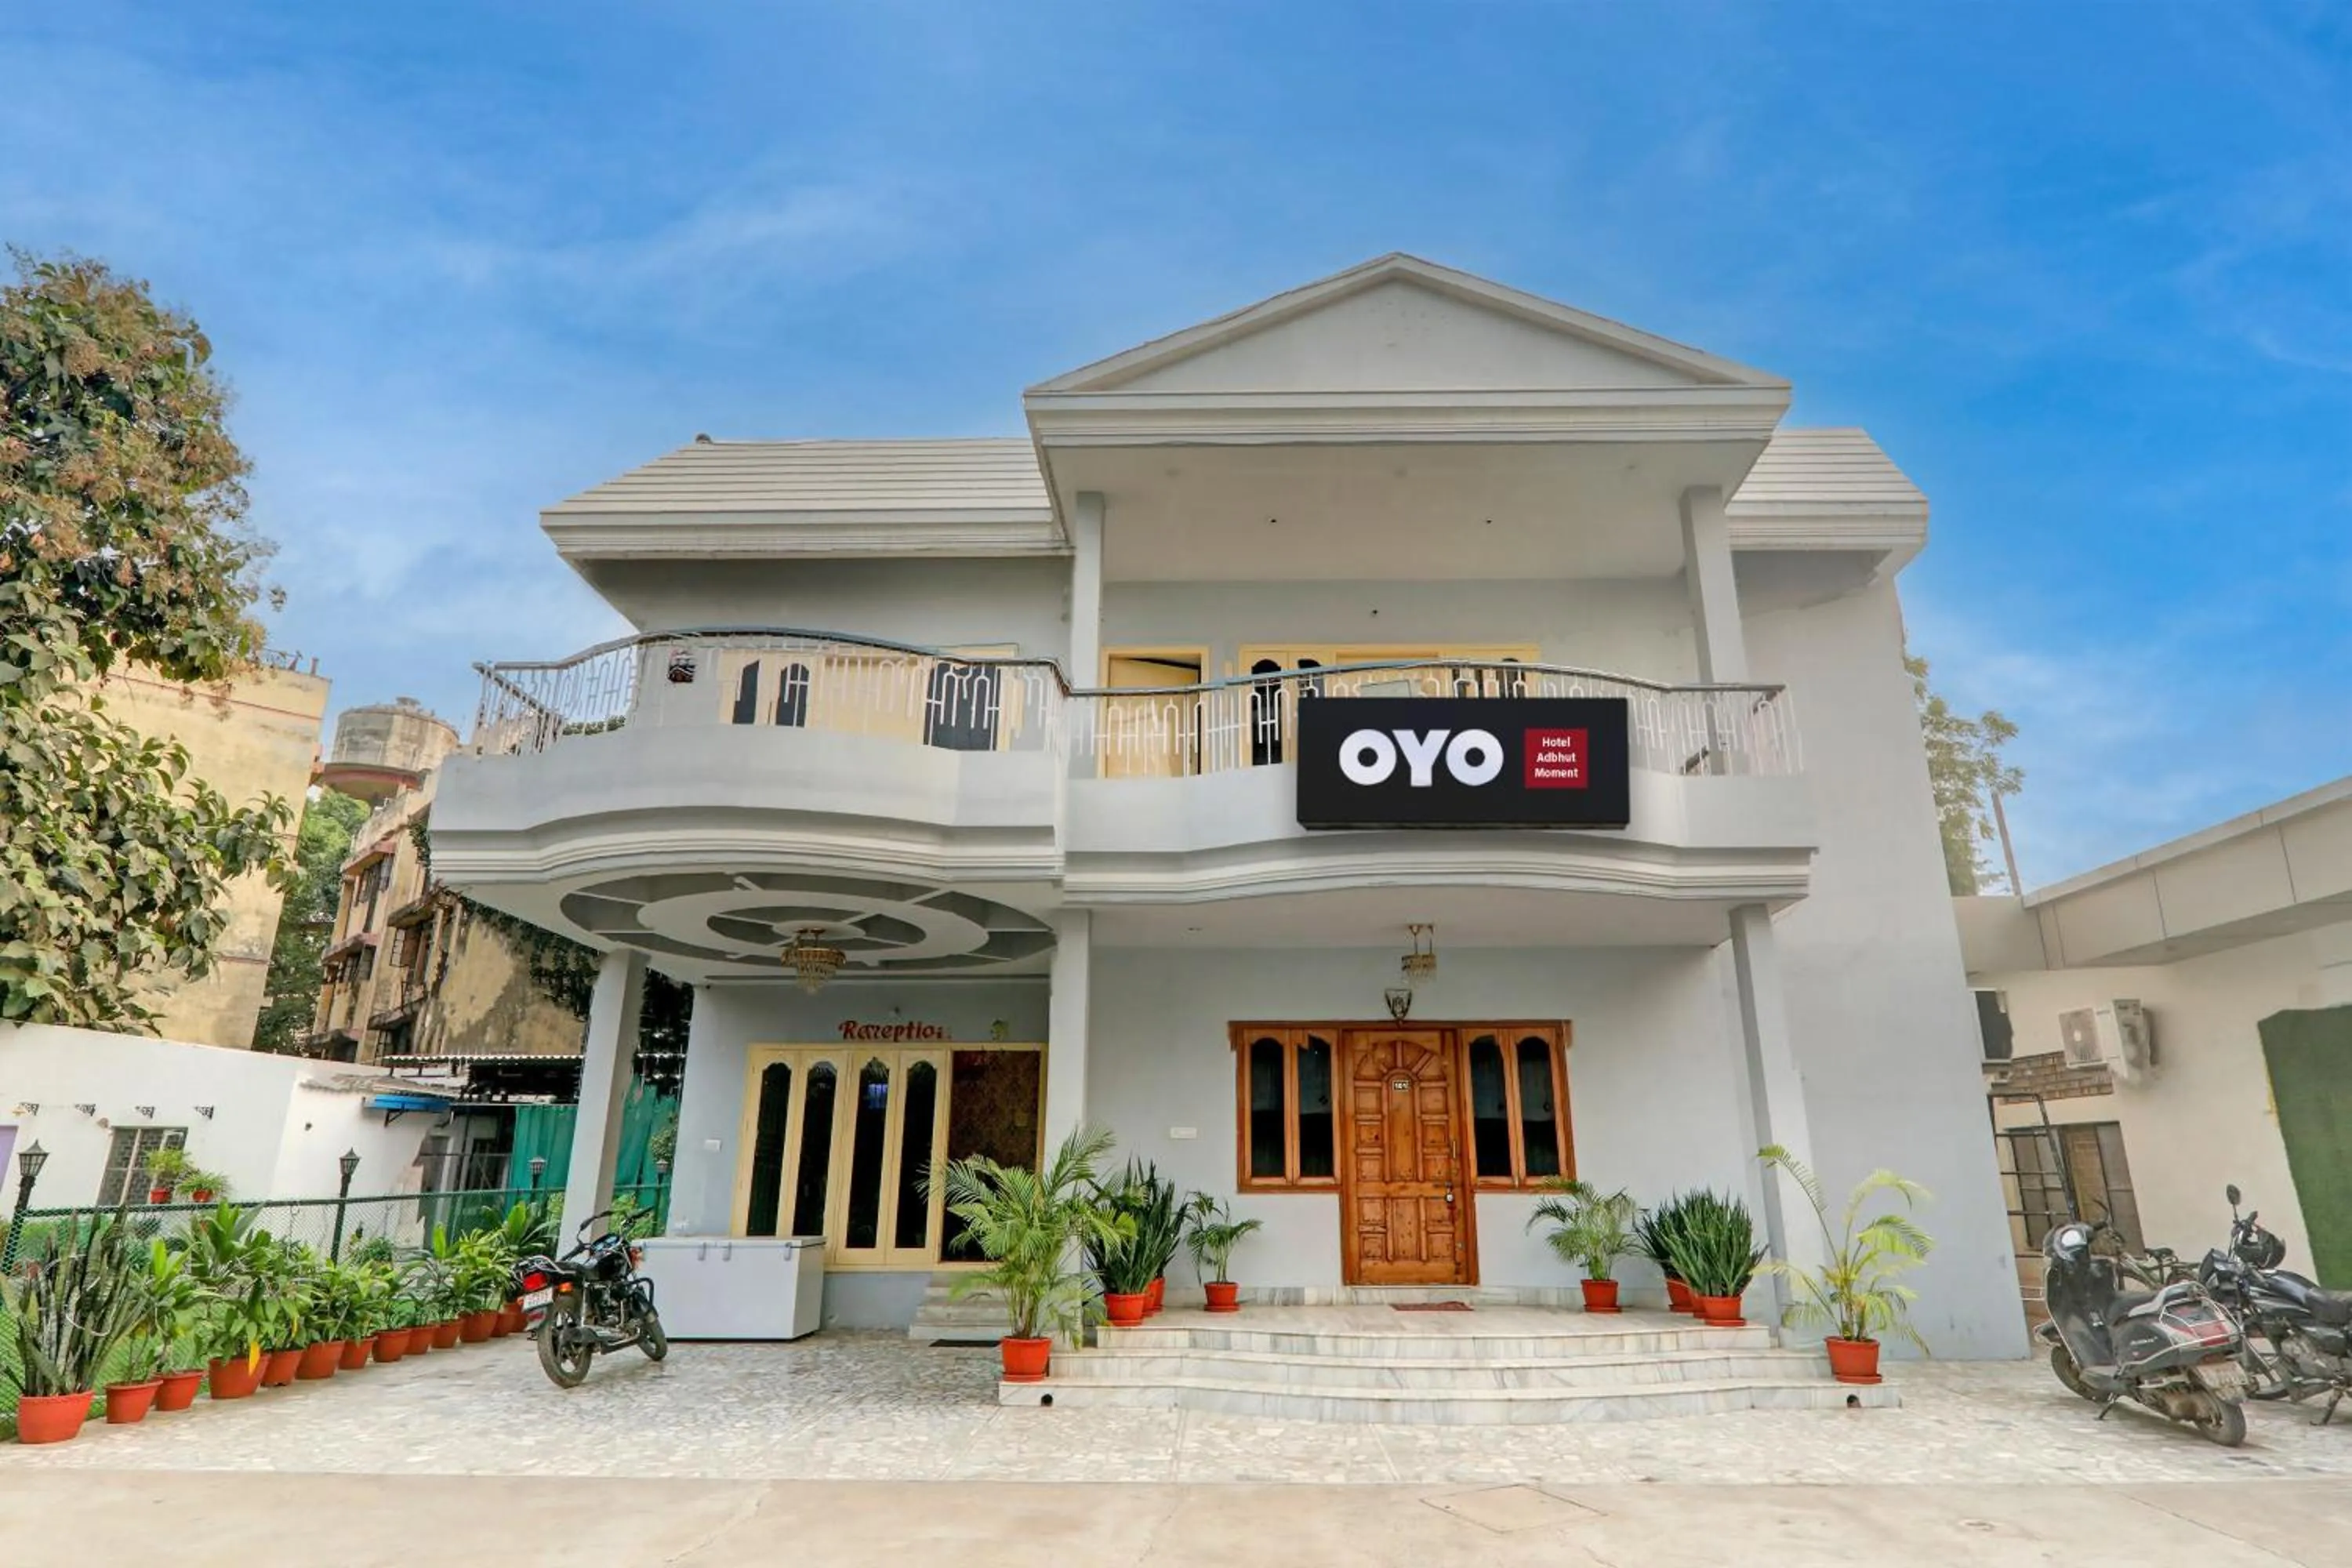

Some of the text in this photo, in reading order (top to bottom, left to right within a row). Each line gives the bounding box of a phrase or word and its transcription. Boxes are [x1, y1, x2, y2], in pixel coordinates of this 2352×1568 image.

[1542, 736, 1571, 747] Hotel
[1338, 728, 1504, 786] OYO
[1537, 752, 1576, 763] Adbhut
[1534, 768, 1579, 779] Moment
